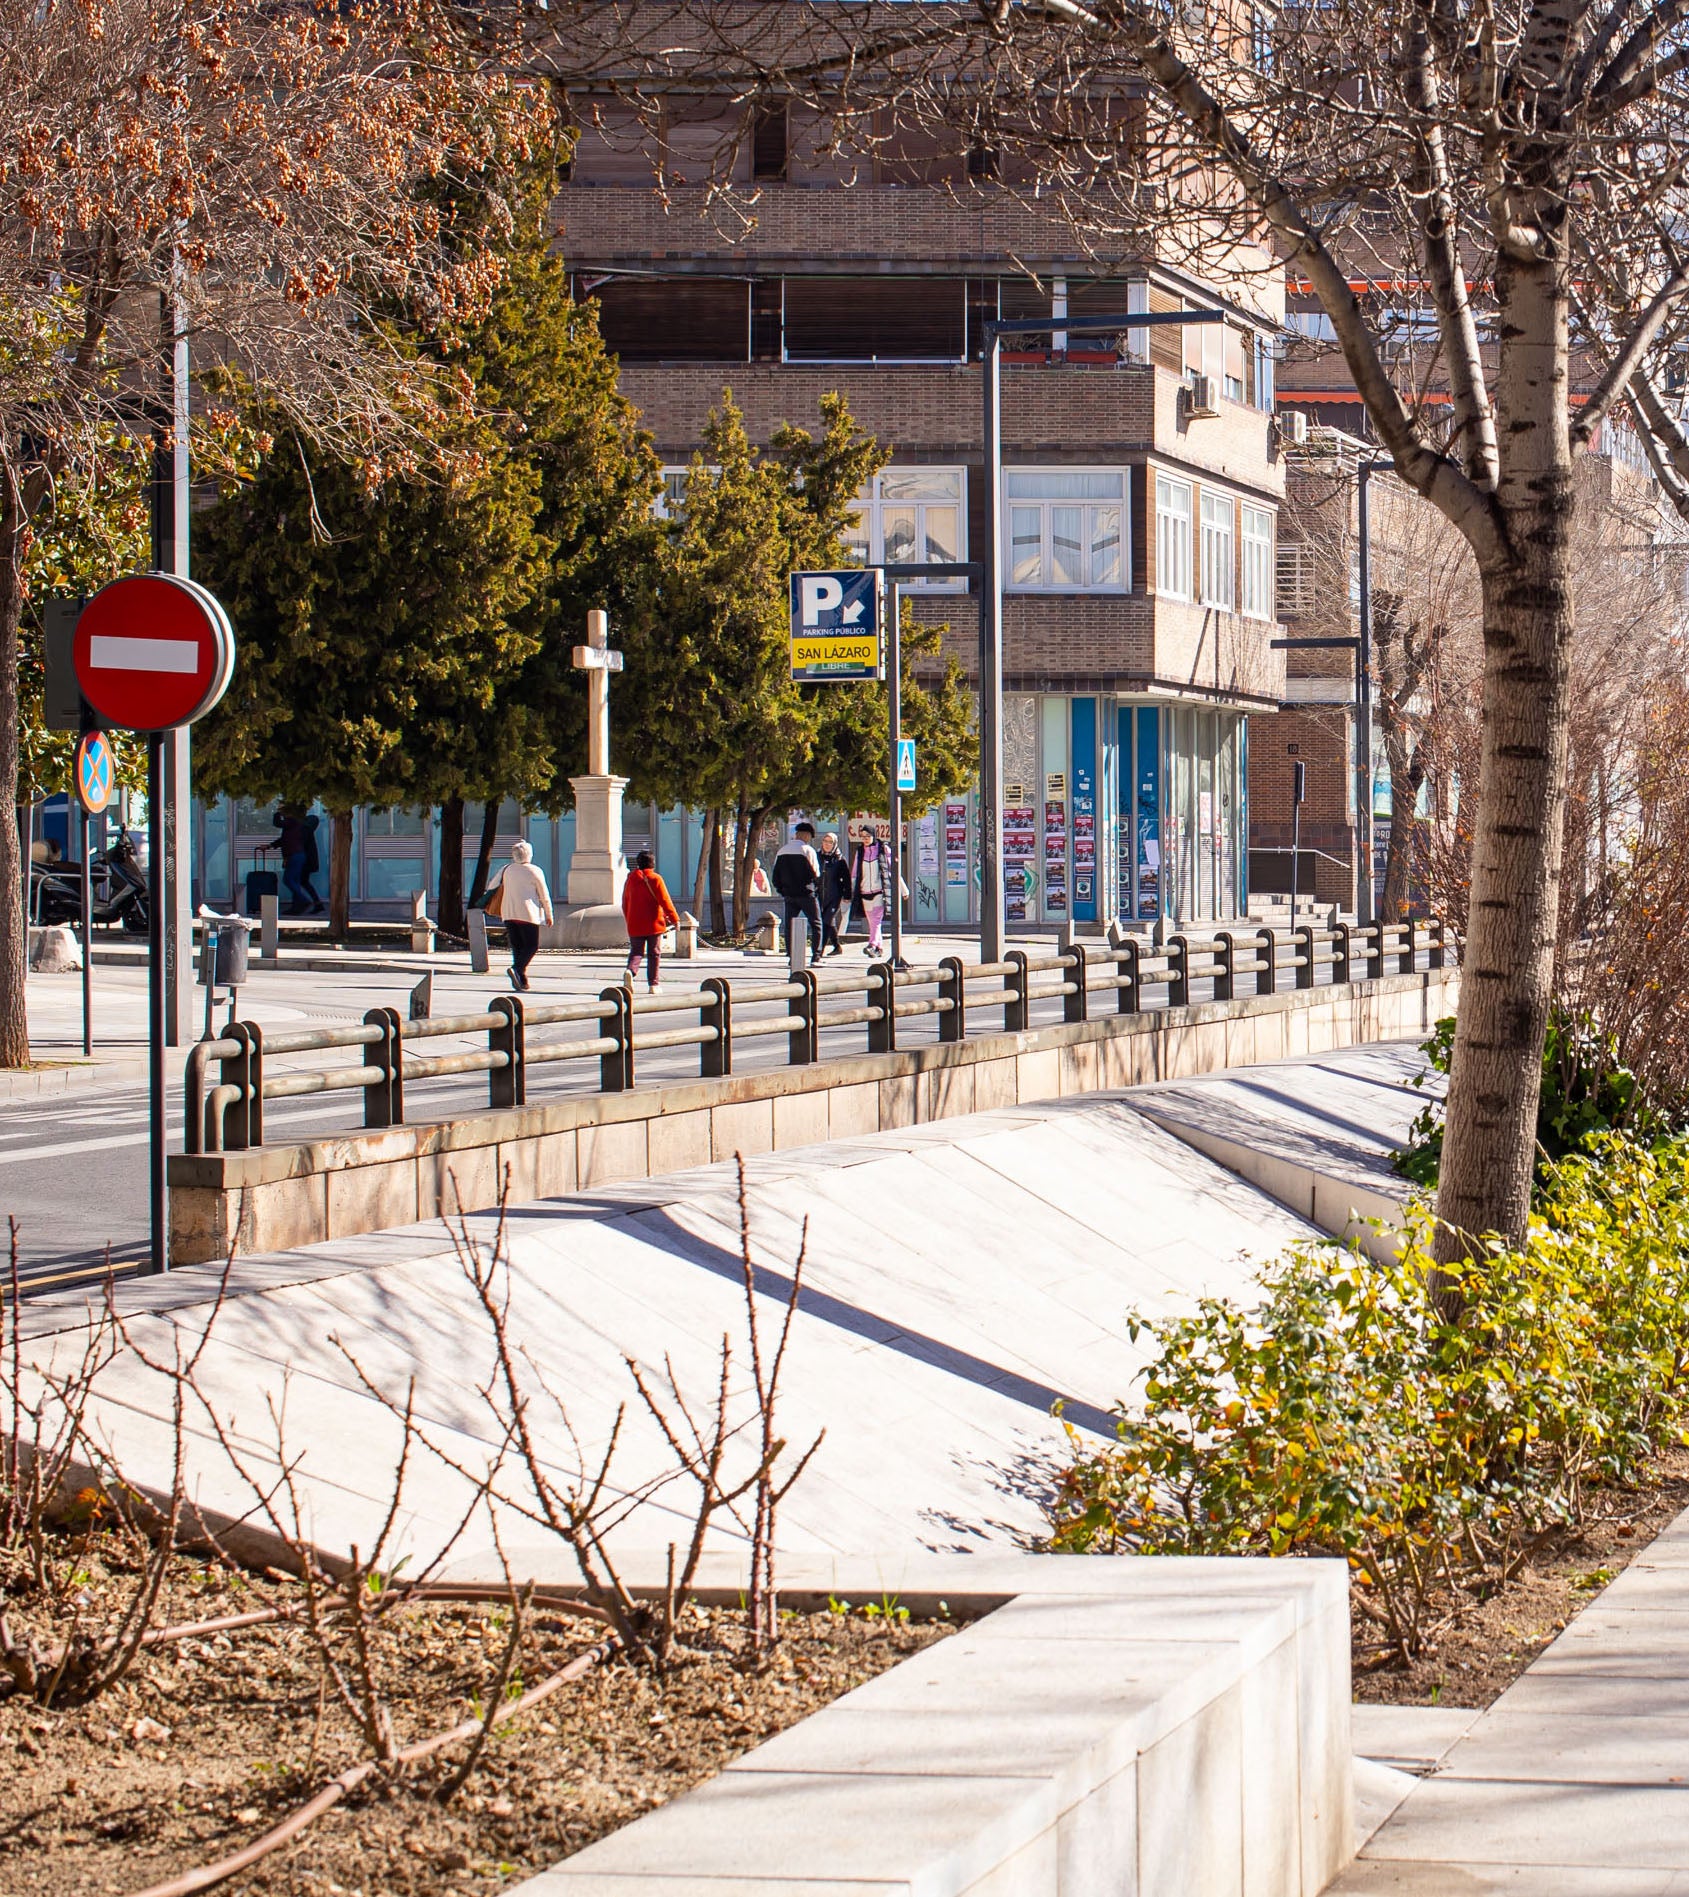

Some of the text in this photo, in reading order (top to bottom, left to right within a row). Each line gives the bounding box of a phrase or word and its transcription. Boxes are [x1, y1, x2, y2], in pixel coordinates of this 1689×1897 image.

[802, 576, 843, 626] P
[802, 626, 866, 636] PARKING PÚBLICO
[797, 644, 871, 659] SAN LÁZARO
